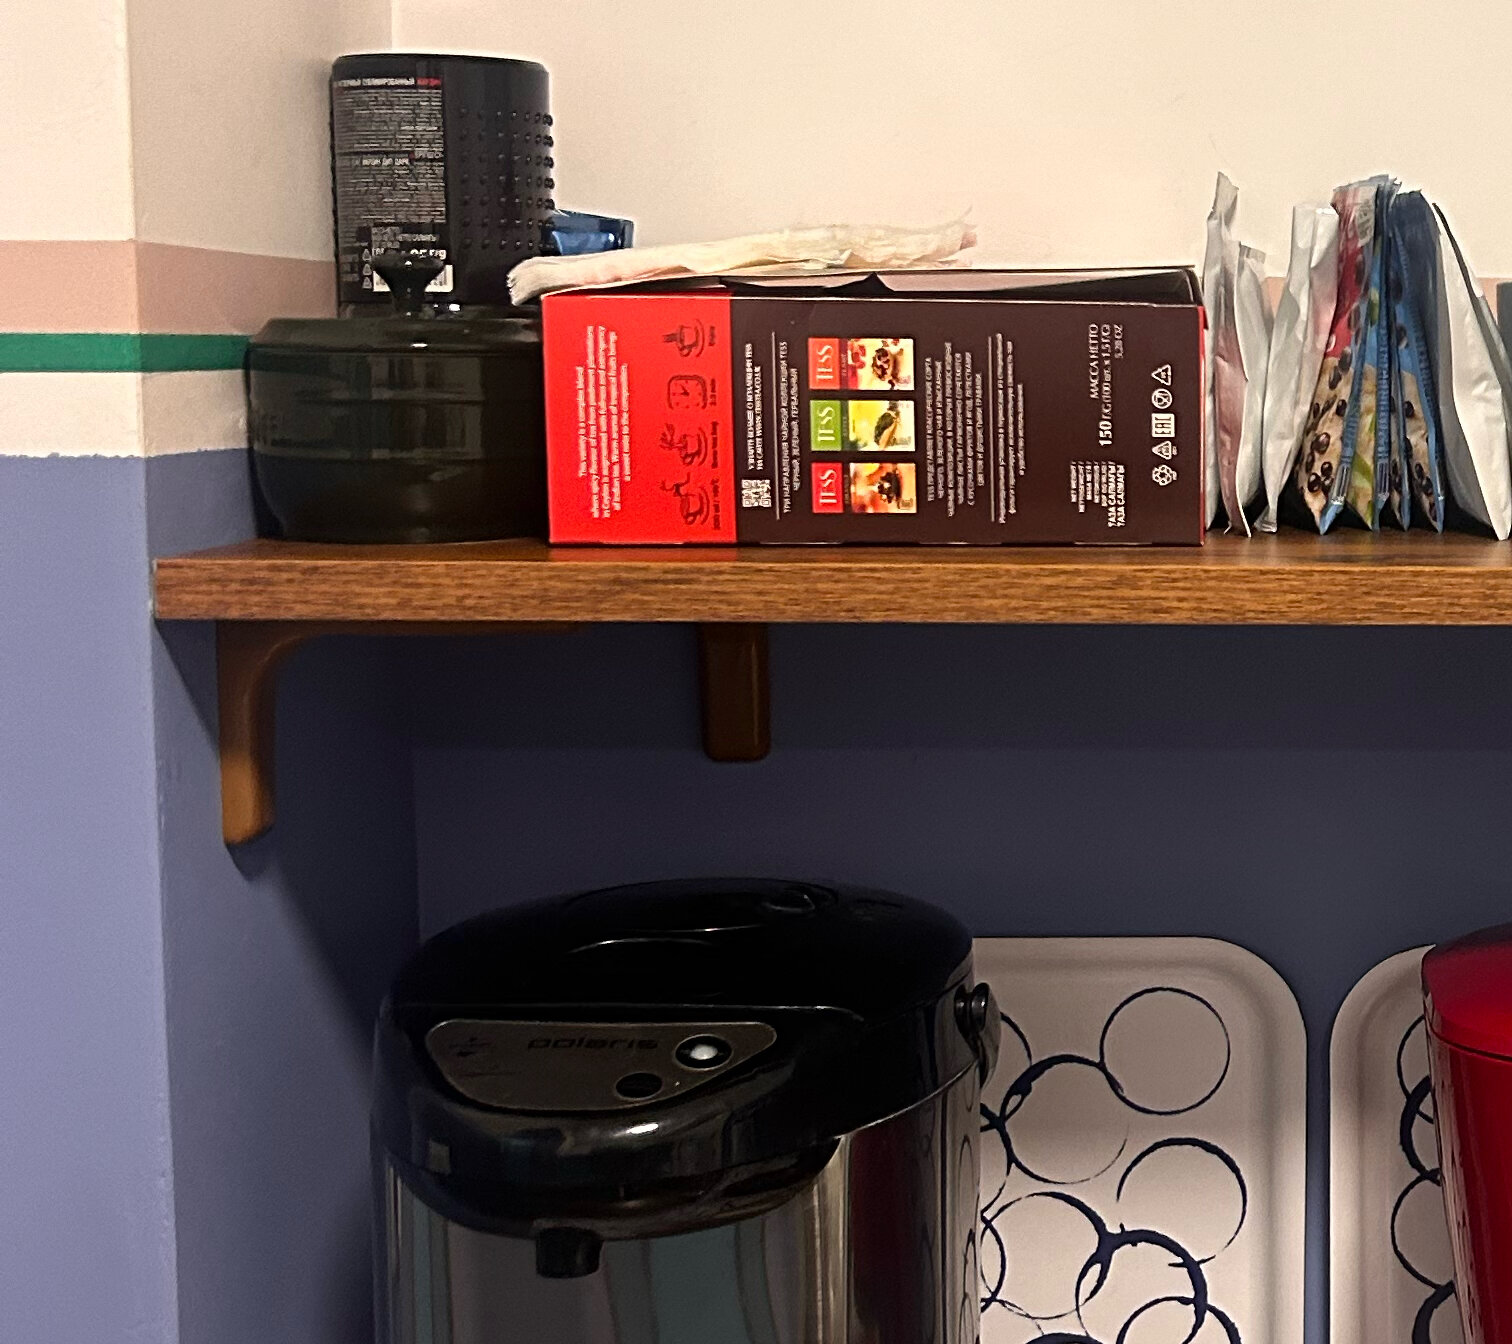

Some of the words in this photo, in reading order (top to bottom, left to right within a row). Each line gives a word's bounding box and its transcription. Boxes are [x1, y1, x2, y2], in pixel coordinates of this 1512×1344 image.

[1089, 360, 1099, 399] МАССА
[1098, 420, 1113, 447] 150
[527, 1036, 659, 1050] polaris
